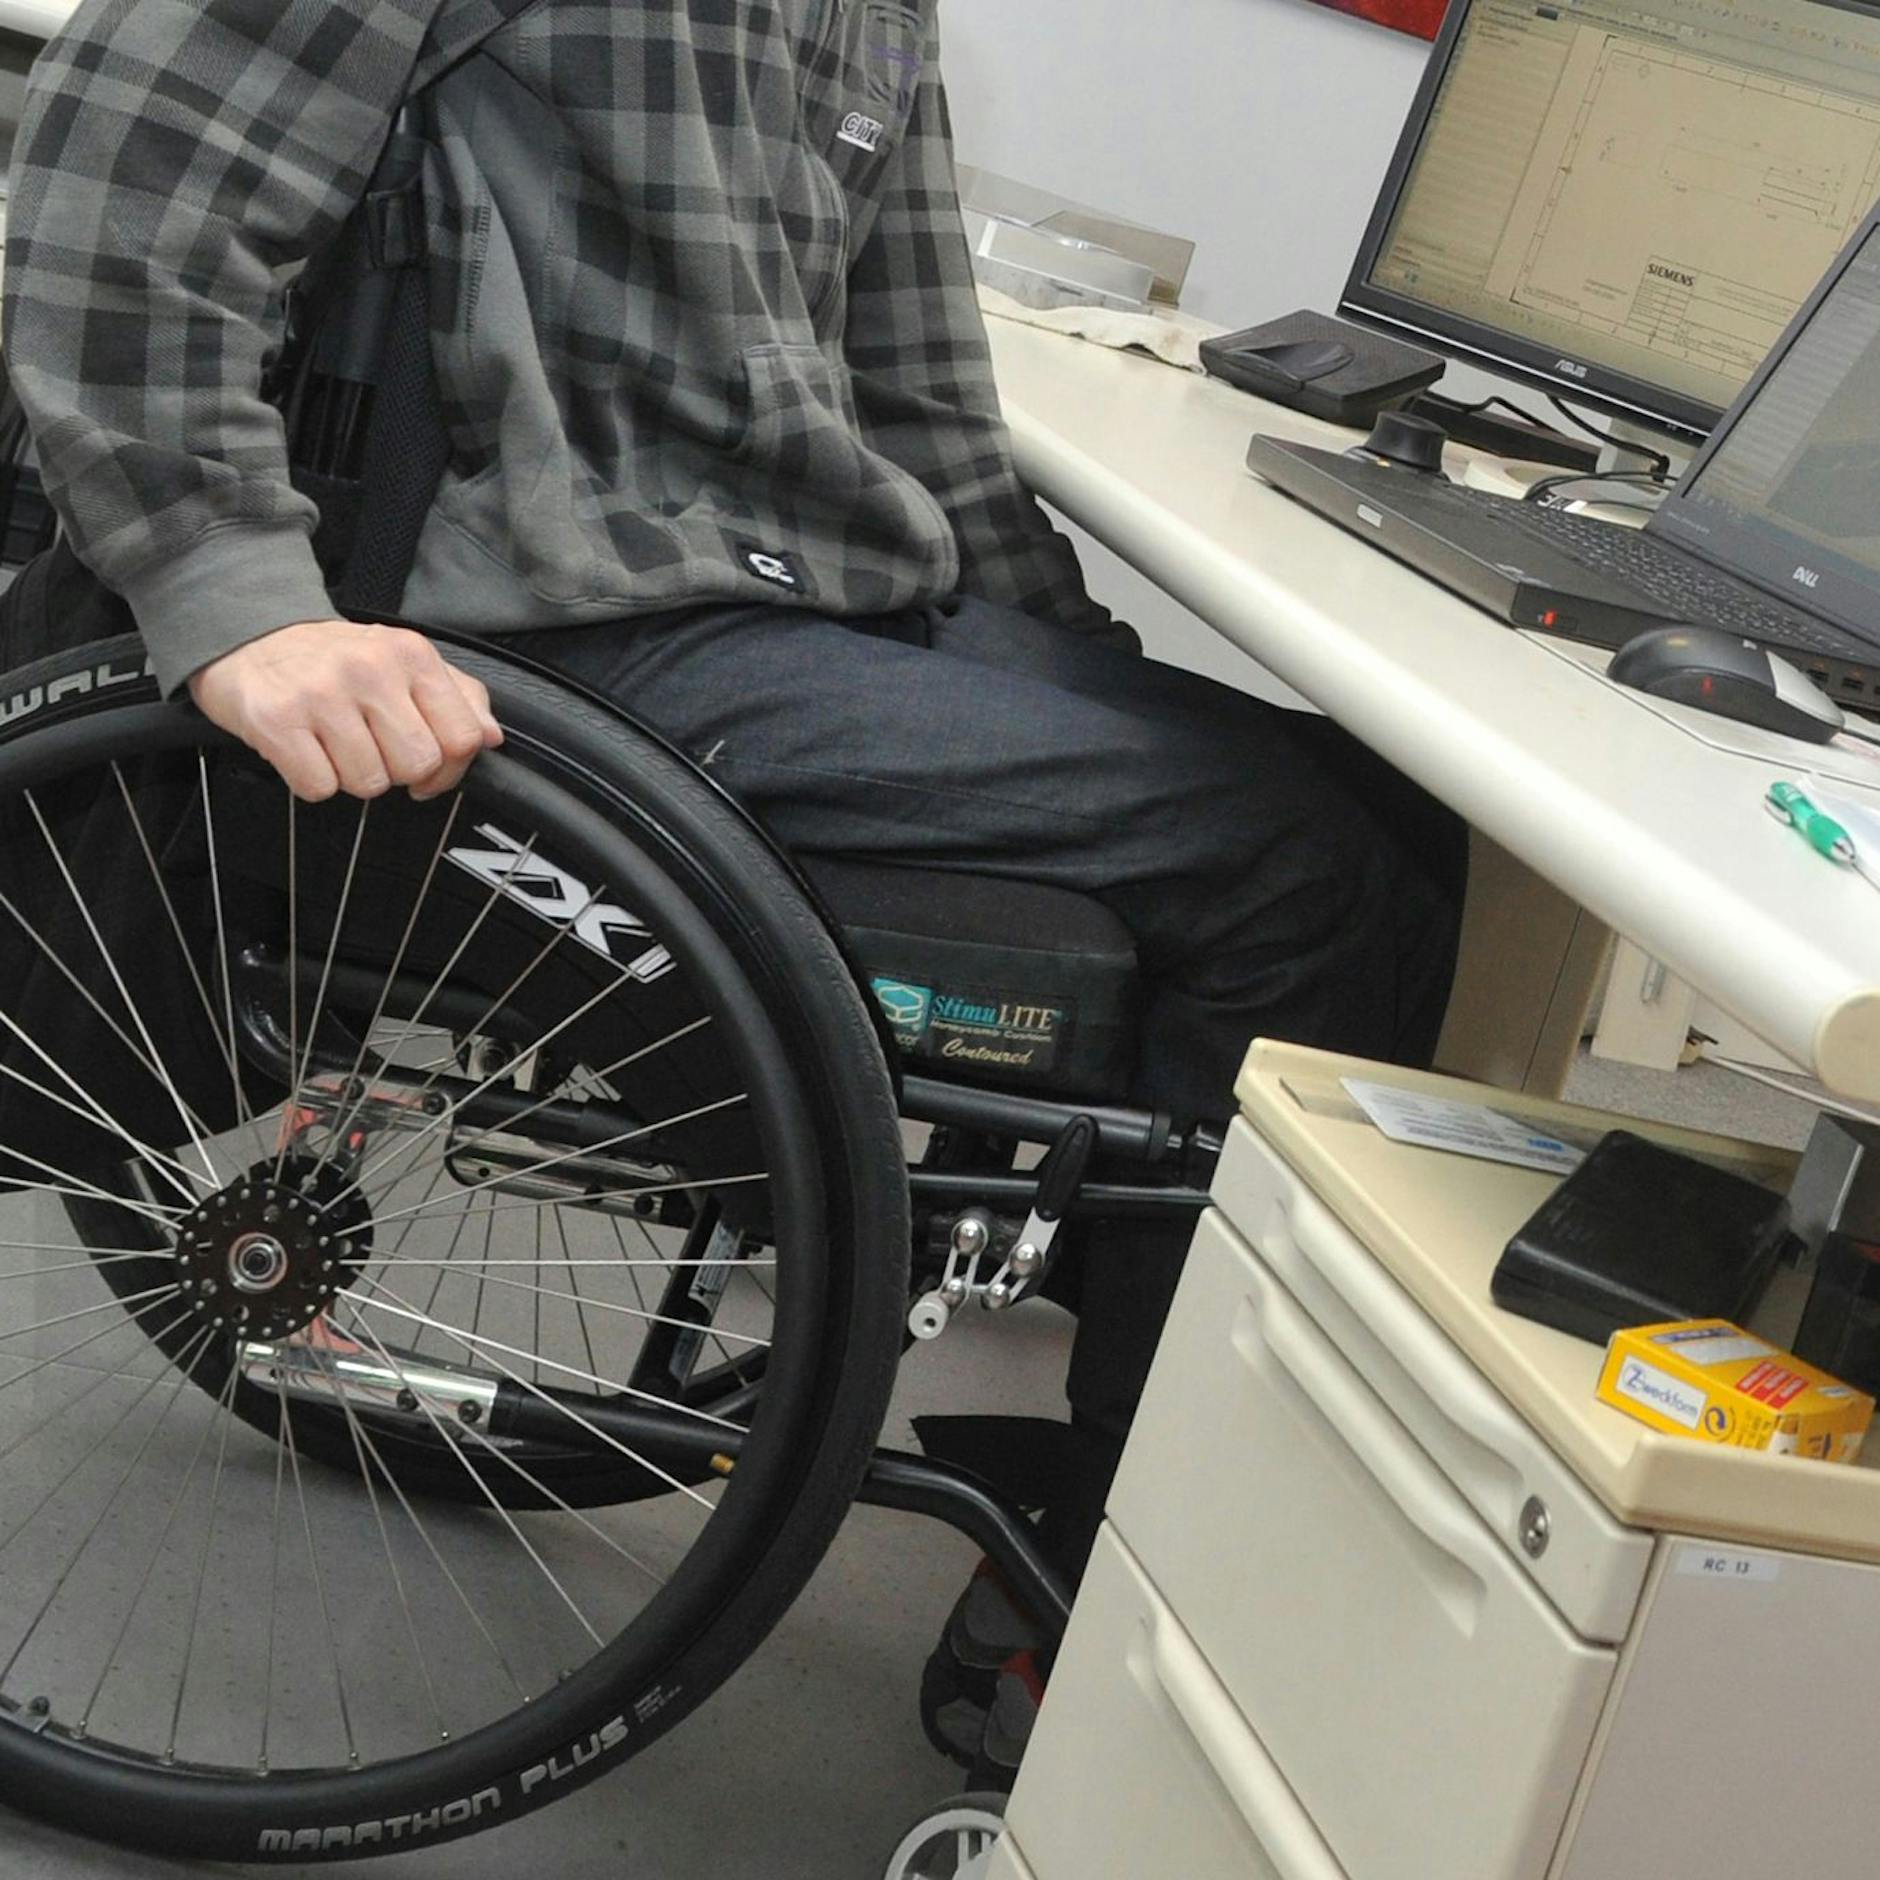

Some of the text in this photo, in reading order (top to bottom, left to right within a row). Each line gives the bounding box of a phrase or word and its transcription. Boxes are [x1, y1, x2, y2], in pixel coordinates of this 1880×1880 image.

[1647, 263, 1696, 287] SIEMENS
[1792, 566, 1820, 588] DELL
[0, 657, 155, 726] WAL
[942, 1038, 1034, 1065] Contoured
[257, 1715, 629, 1852] MARATHON PLUS
